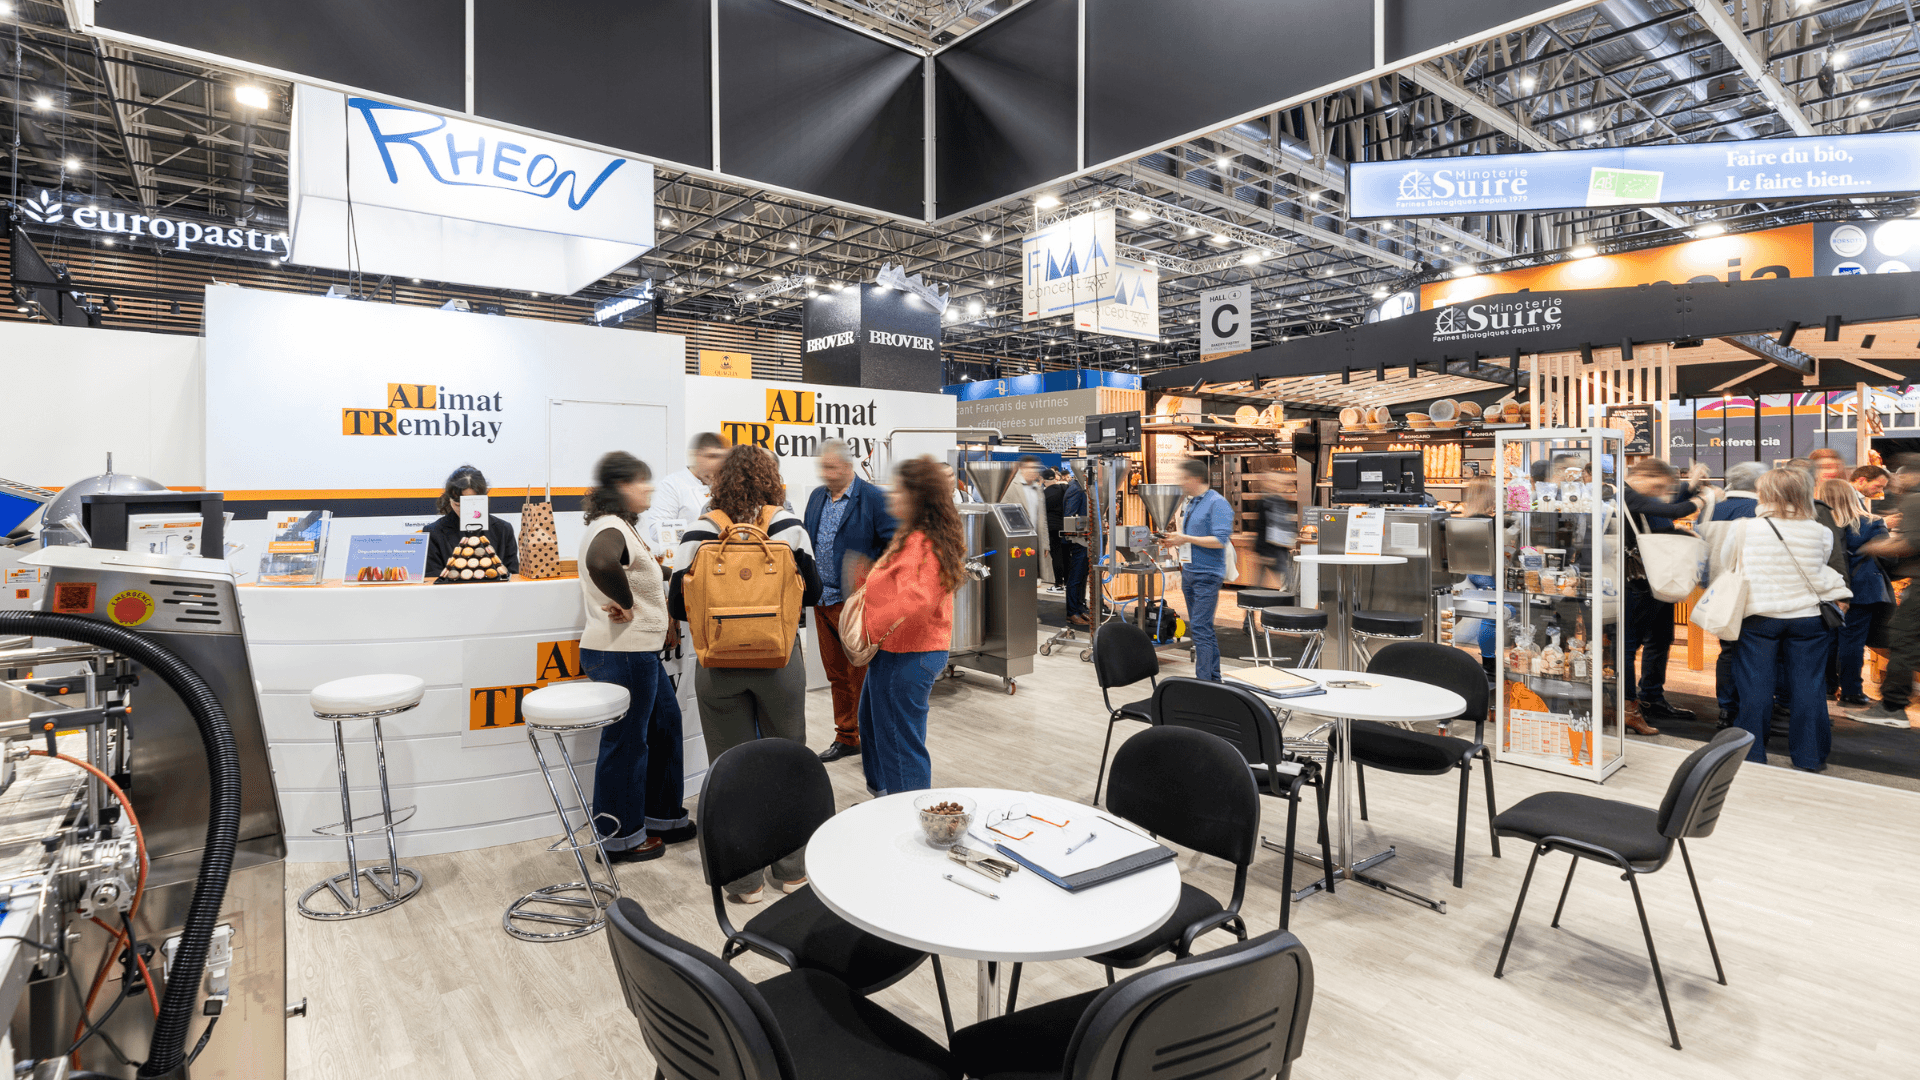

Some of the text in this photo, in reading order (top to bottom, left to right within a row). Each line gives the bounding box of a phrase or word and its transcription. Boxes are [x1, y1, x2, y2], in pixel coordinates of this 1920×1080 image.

[348, 97, 627, 211] RHEON
[1726, 145, 1854, 167] Faire du bio,
[1432, 169, 1528, 199] Suire
[1456, 167, 1528, 180] Minoterie
[1726, 175, 1751, 192] Le
[1754, 173, 1803, 190] faire
[1427, 197, 1477, 207] Biologiques
[1478, 196, 1507, 205] depuis
[1509, 195, 1528, 203] 1979
[72, 206, 290, 261] europastry
[1028, 276, 1081, 300] concept
[1210, 294, 1227, 303] HALL
[1489, 297, 1562, 313] Minoterie
[1211, 303, 1239, 338] C
[1466, 304, 1562, 332] Suire
[806, 331, 854, 353] BROVER
[869, 330, 935, 351] BROVER
[1461, 330, 1510, 340] Biologiques
[1511, 327, 1540, 335] depuis
[1542, 323, 1562, 331] 1979
[388, 384, 503, 412] ALimat
[766, 390, 877, 426] ALimat
[975, 401, 1013, 414] Français
[1015, 399, 1027, 411] de
[1030, 396, 1069, 409] vitrines
[345, 410, 503, 444] TRemblay
[977, 416, 1085, 430] réfrigérées sur mesure
[723, 422, 876, 458] TRemay
[1709, 437, 1781, 447] Referecia
[111, 591, 153, 607] EMERGENCY
